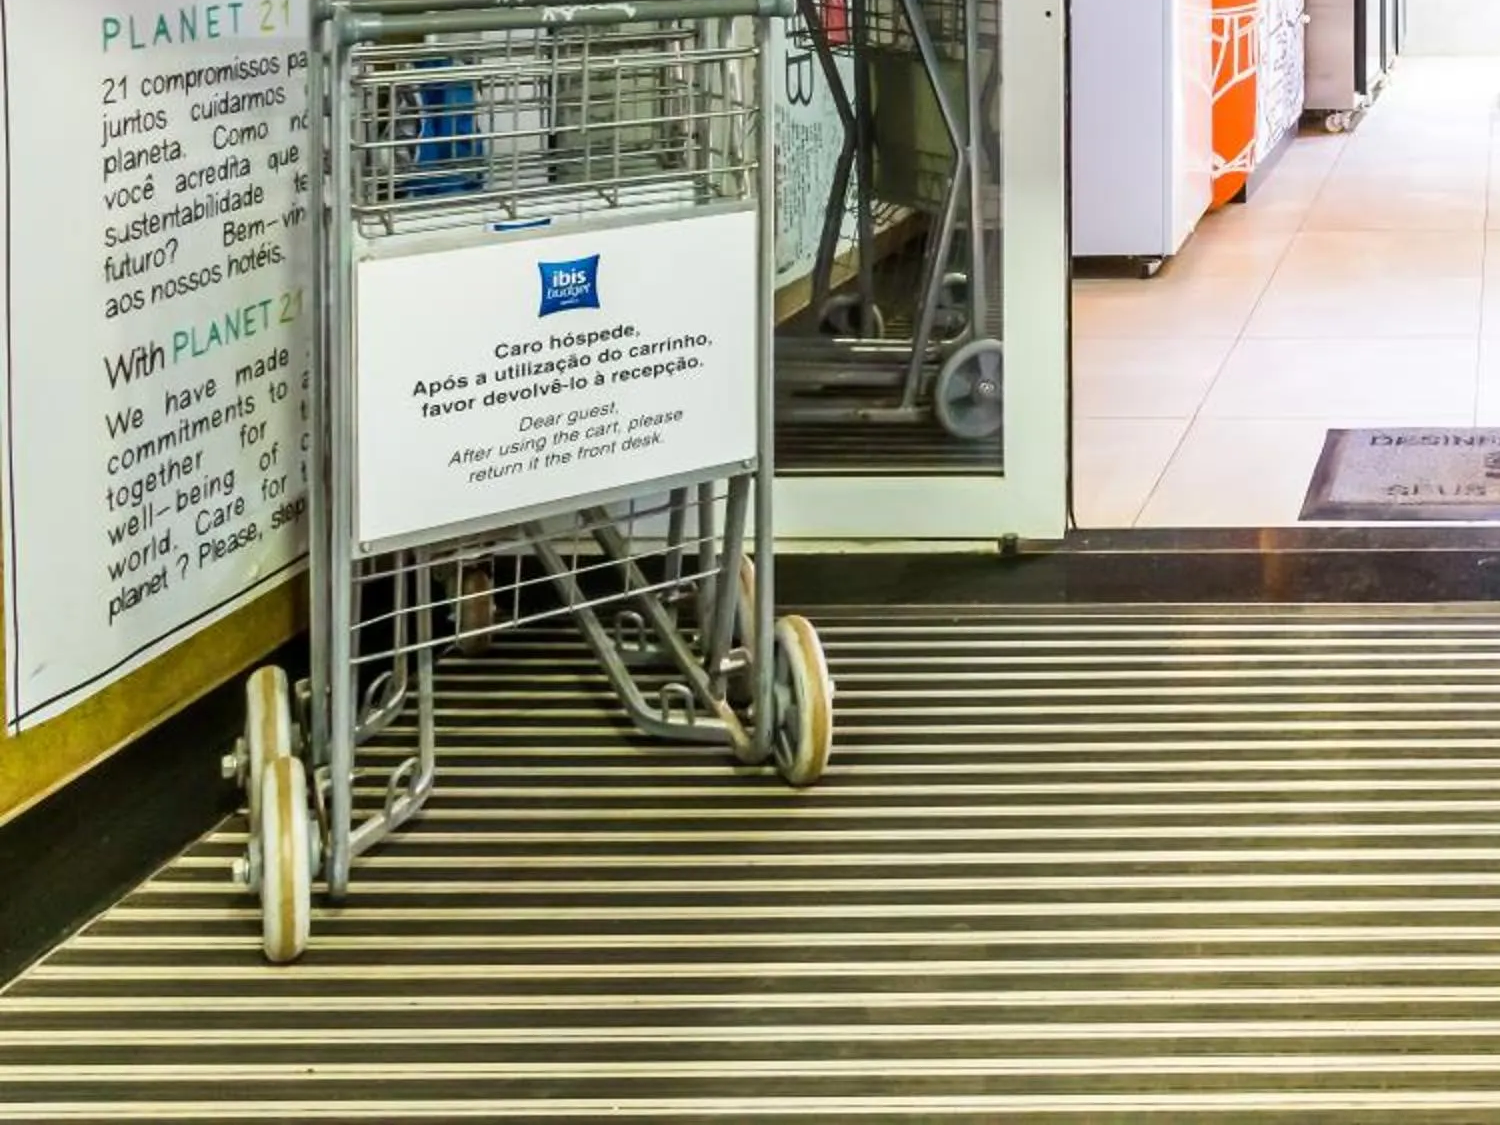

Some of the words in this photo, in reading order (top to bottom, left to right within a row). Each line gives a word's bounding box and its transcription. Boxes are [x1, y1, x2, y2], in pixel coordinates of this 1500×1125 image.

[102, 2, 243, 52] PLANET
[102, 75, 128, 104] 21
[141, 54, 281, 97] compromissos
[287, 50, 308, 76] pa
[102, 109, 168, 148] juntos
[191, 85, 286, 121] cuidarmos
[103, 139, 187, 182] planeta.
[213, 121, 269, 150] Como
[104, 174, 155, 211] você
[175, 155, 251, 193] acredita
[268, 144, 299, 173] que
[104, 183, 264, 248] sustentabilidade
[104, 238, 179, 283] futuro?
[104, 290, 145, 319] aos
[151, 264, 222, 303] nossos
[227, 243, 286, 278] hotéis.
[546, 283, 591, 299] budget
[553, 268, 587, 287] ibis
[104, 341, 165, 390] With
[172, 299, 272, 364] PLANET
[413, 374, 469, 399] Após
[475, 371, 488, 386] a
[494, 350, 590, 382] utilização
[597, 344, 623, 365] do
[628, 330, 714, 359] carrinho,
[495, 337, 542, 359] Caro
[550, 323, 642, 350] hóspede,
[105, 408, 144, 440] We
[165, 377, 217, 415] have
[235, 347, 289, 385] made
[422, 393, 476, 419] favor
[483, 375, 588, 408] devolvê-lo
[593, 367, 606, 386] à
[611, 355, 705, 385] recepção.
[519, 410, 562, 432] Dear
[567, 400, 620, 427] guest,
[107, 394, 256, 475] commitments
[268, 381, 288, 404] to
[449, 446, 493, 468] After
[499, 435, 547, 458] using
[553, 426, 579, 447] the
[585, 420, 622, 438] cart,
[628, 409, 685, 433] please
[468, 459, 523, 484] return
[528, 452, 540, 473] it
[545, 447, 572, 467] the
[577, 439, 617, 462] front
[622, 431, 666, 454] desk.
[107, 450, 204, 512] together
[239, 421, 267, 449] for
[108, 469, 235, 547] well-being
[259, 442, 280, 471] of
[108, 529, 178, 582] world.
[196, 497, 246, 536] Care
[261, 474, 288, 502] for
[108, 568, 169, 627] planet
[176, 554, 189, 580] ?
[199, 523, 263, 569] Please,
